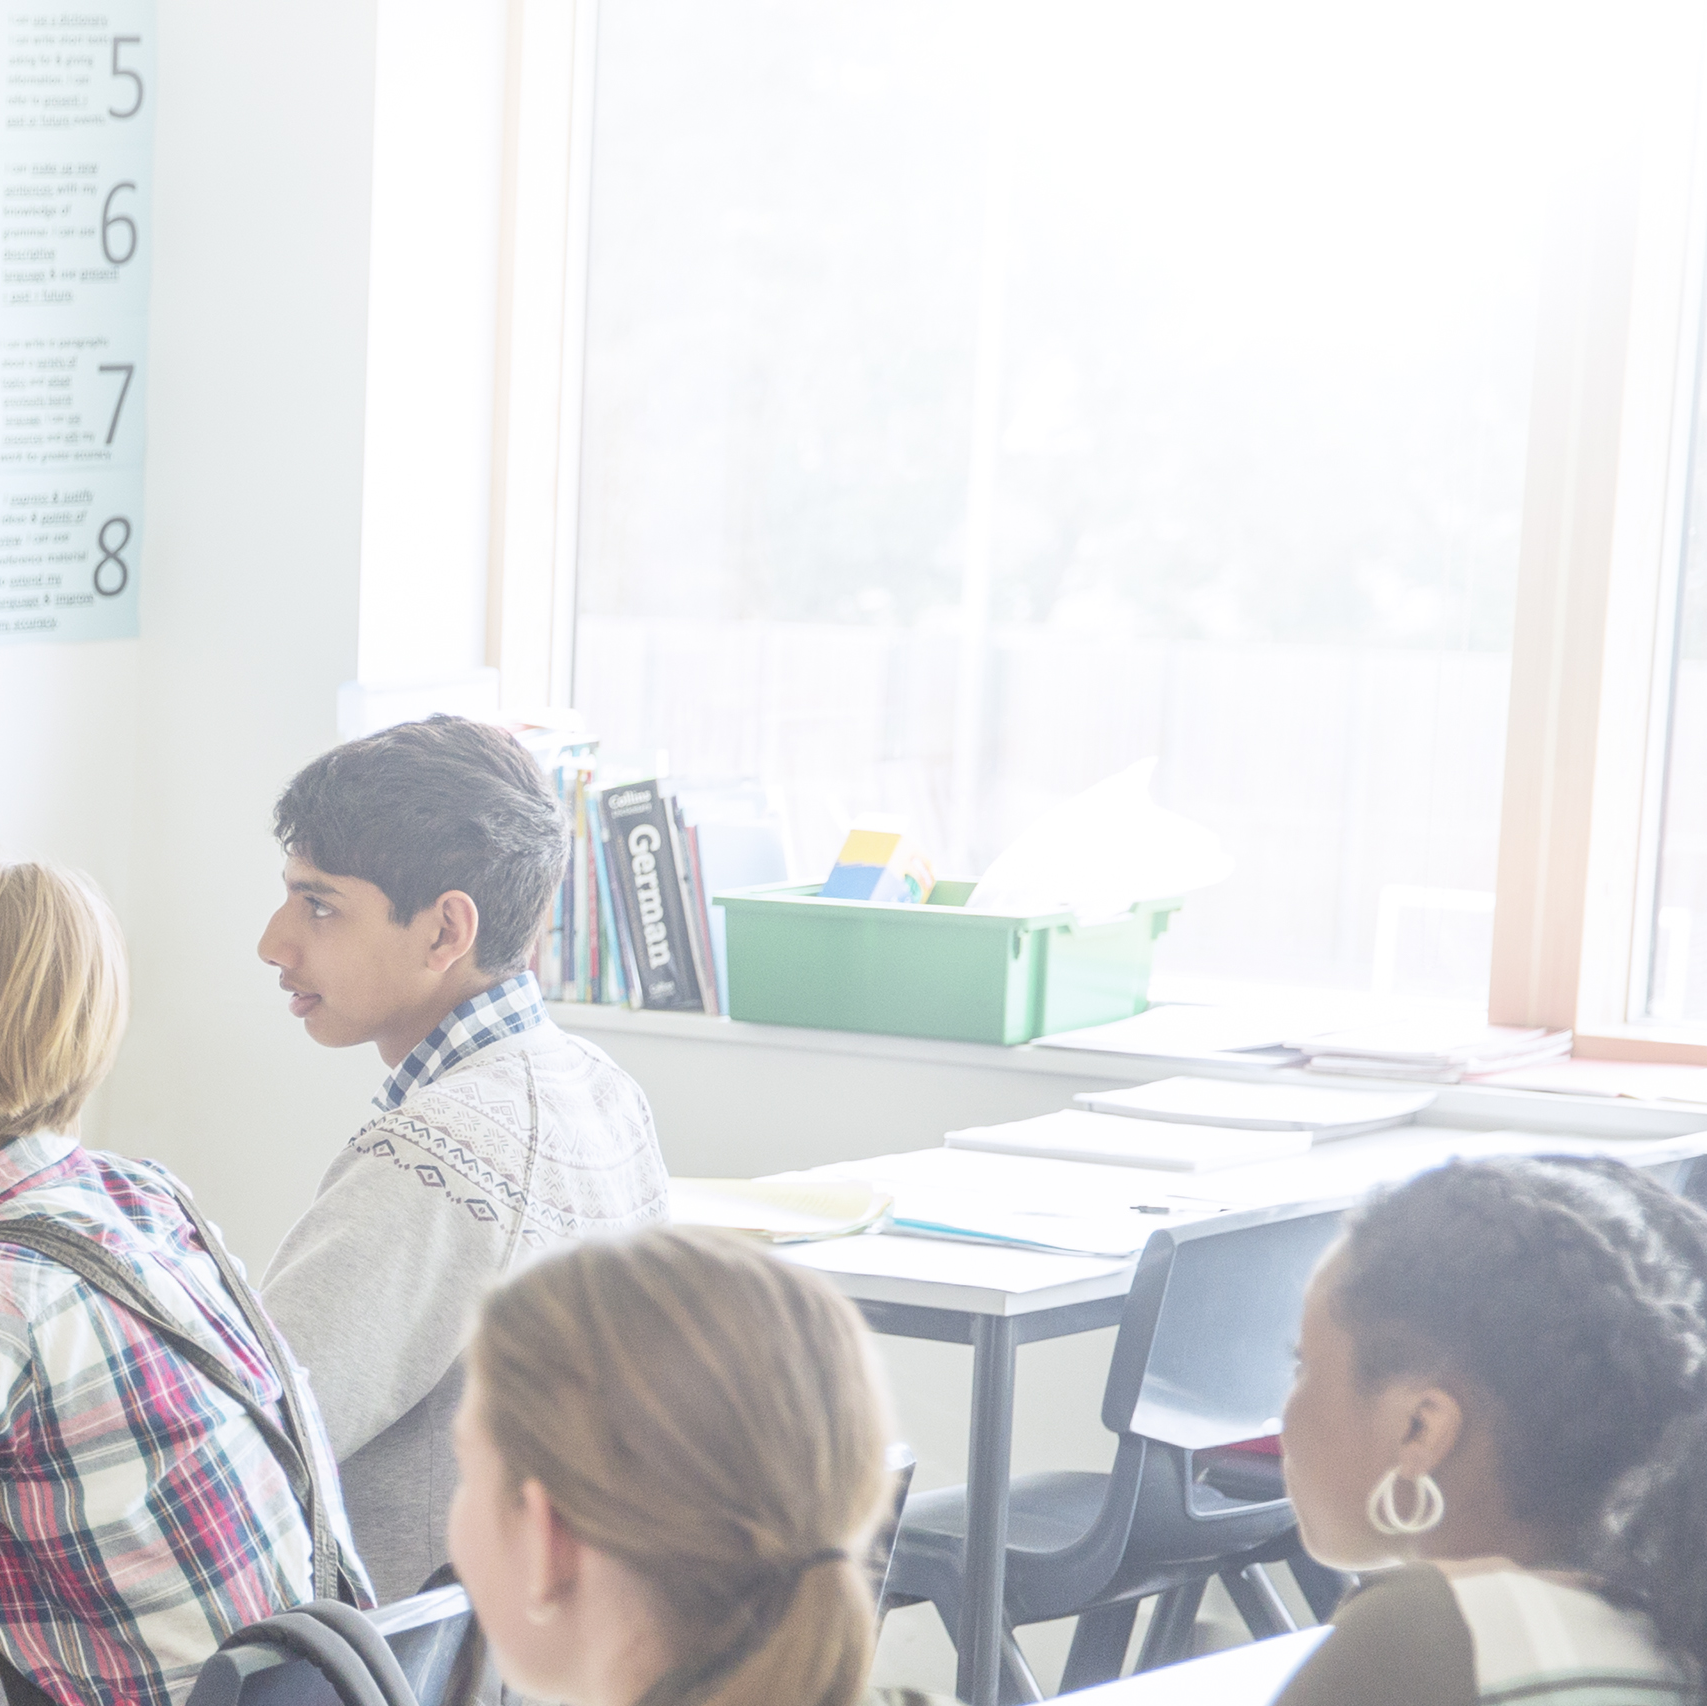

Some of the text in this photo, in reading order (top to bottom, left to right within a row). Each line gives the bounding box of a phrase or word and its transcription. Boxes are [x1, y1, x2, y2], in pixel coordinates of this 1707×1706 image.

[107, 34, 145, 121] 5
[100, 180, 138, 266] 6
[96, 363, 136, 447] 7
[92, 515, 133, 600] 8
[627, 823, 672, 970] German
